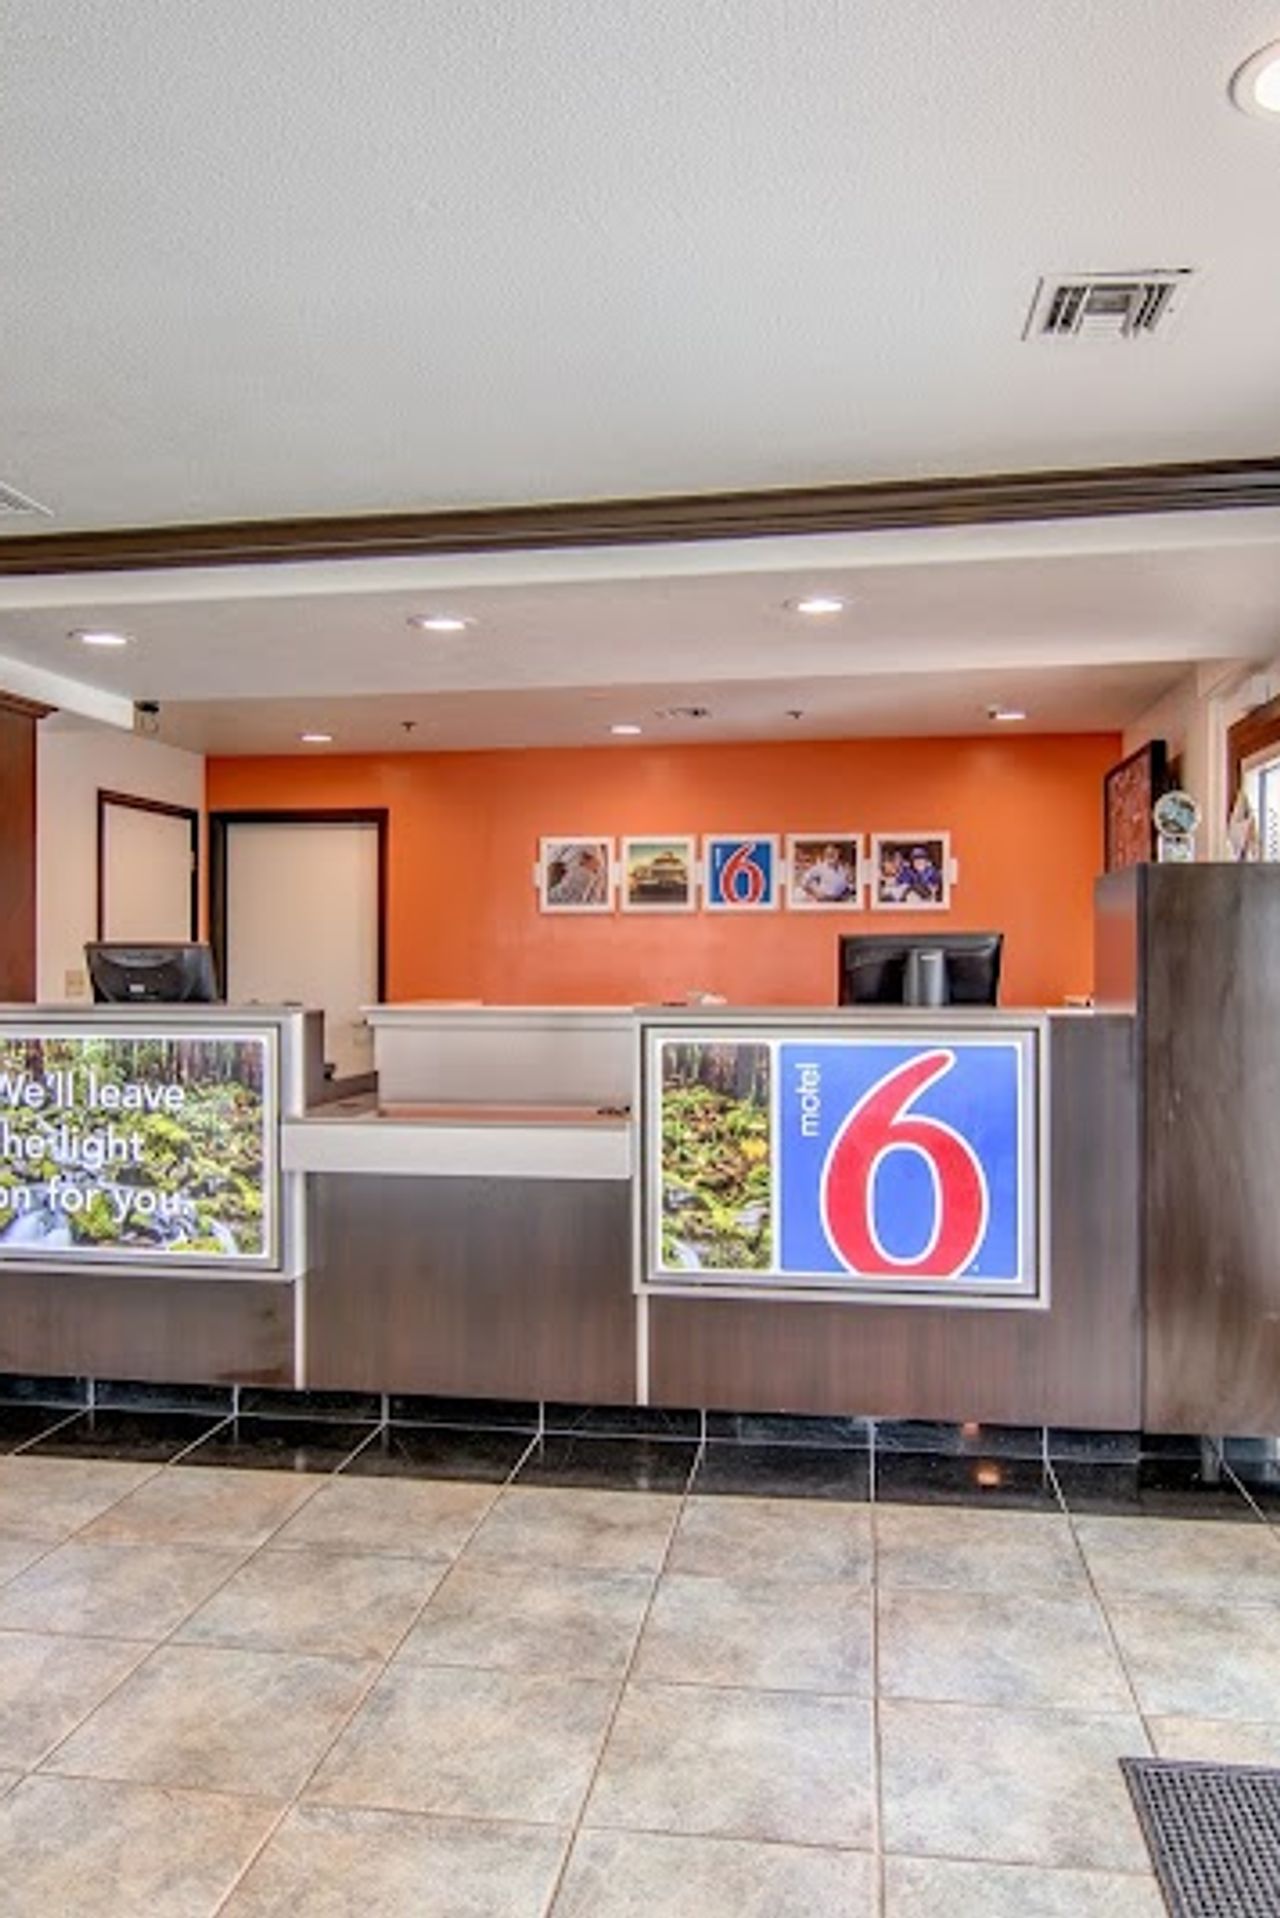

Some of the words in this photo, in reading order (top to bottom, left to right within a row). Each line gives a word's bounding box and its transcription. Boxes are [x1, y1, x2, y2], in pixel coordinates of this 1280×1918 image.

[720, 841, 767, 904] 6
[89, 1072, 186, 1110] leave
[795, 1063, 821, 1137] motel
[0, 1117, 46, 1158] he
[60, 1122, 145, 1170] light
[819, 1049, 989, 1281] 6
[48, 1173, 101, 1213] for
